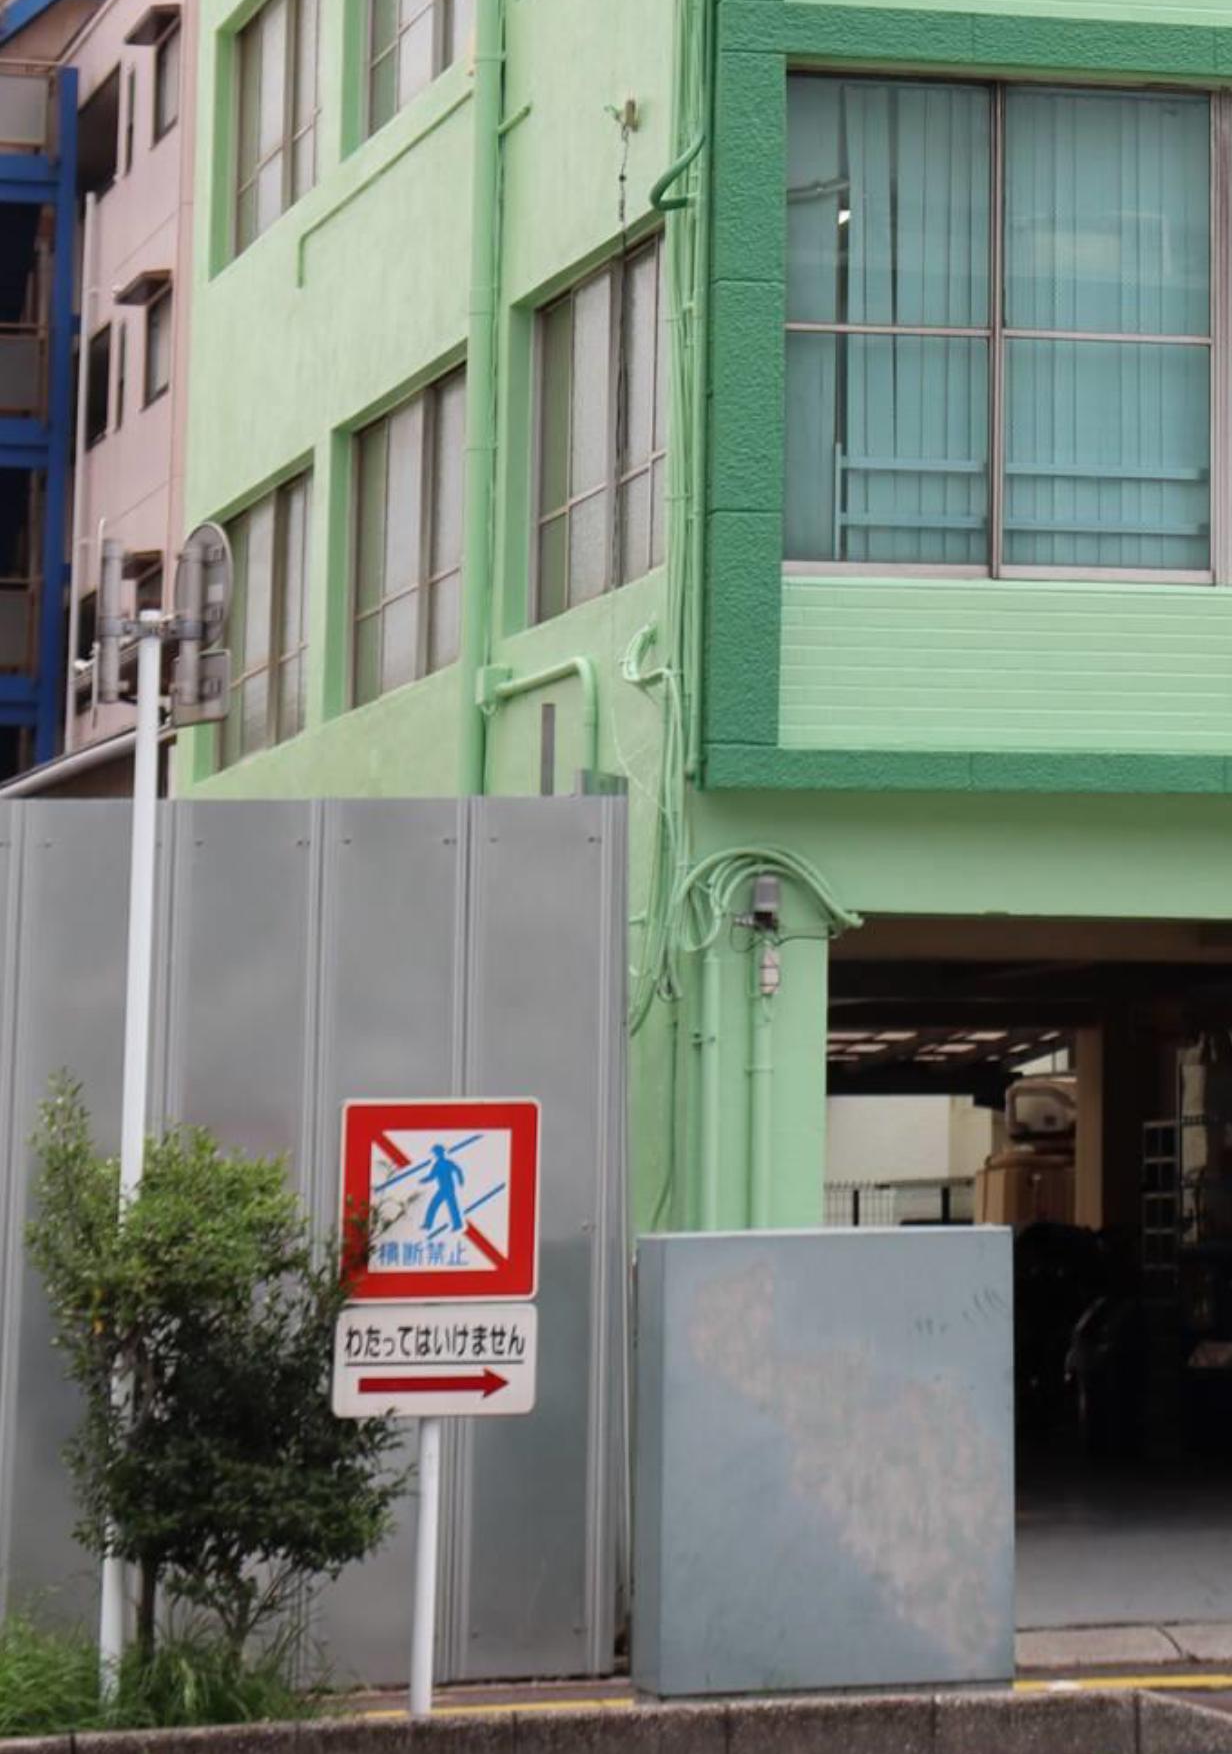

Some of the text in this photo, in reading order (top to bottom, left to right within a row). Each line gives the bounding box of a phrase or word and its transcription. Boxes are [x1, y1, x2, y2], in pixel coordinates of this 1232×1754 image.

[378, 1242, 469, 1266] 横断禁止
[345, 1325, 525, 1358] わたってはいけません
